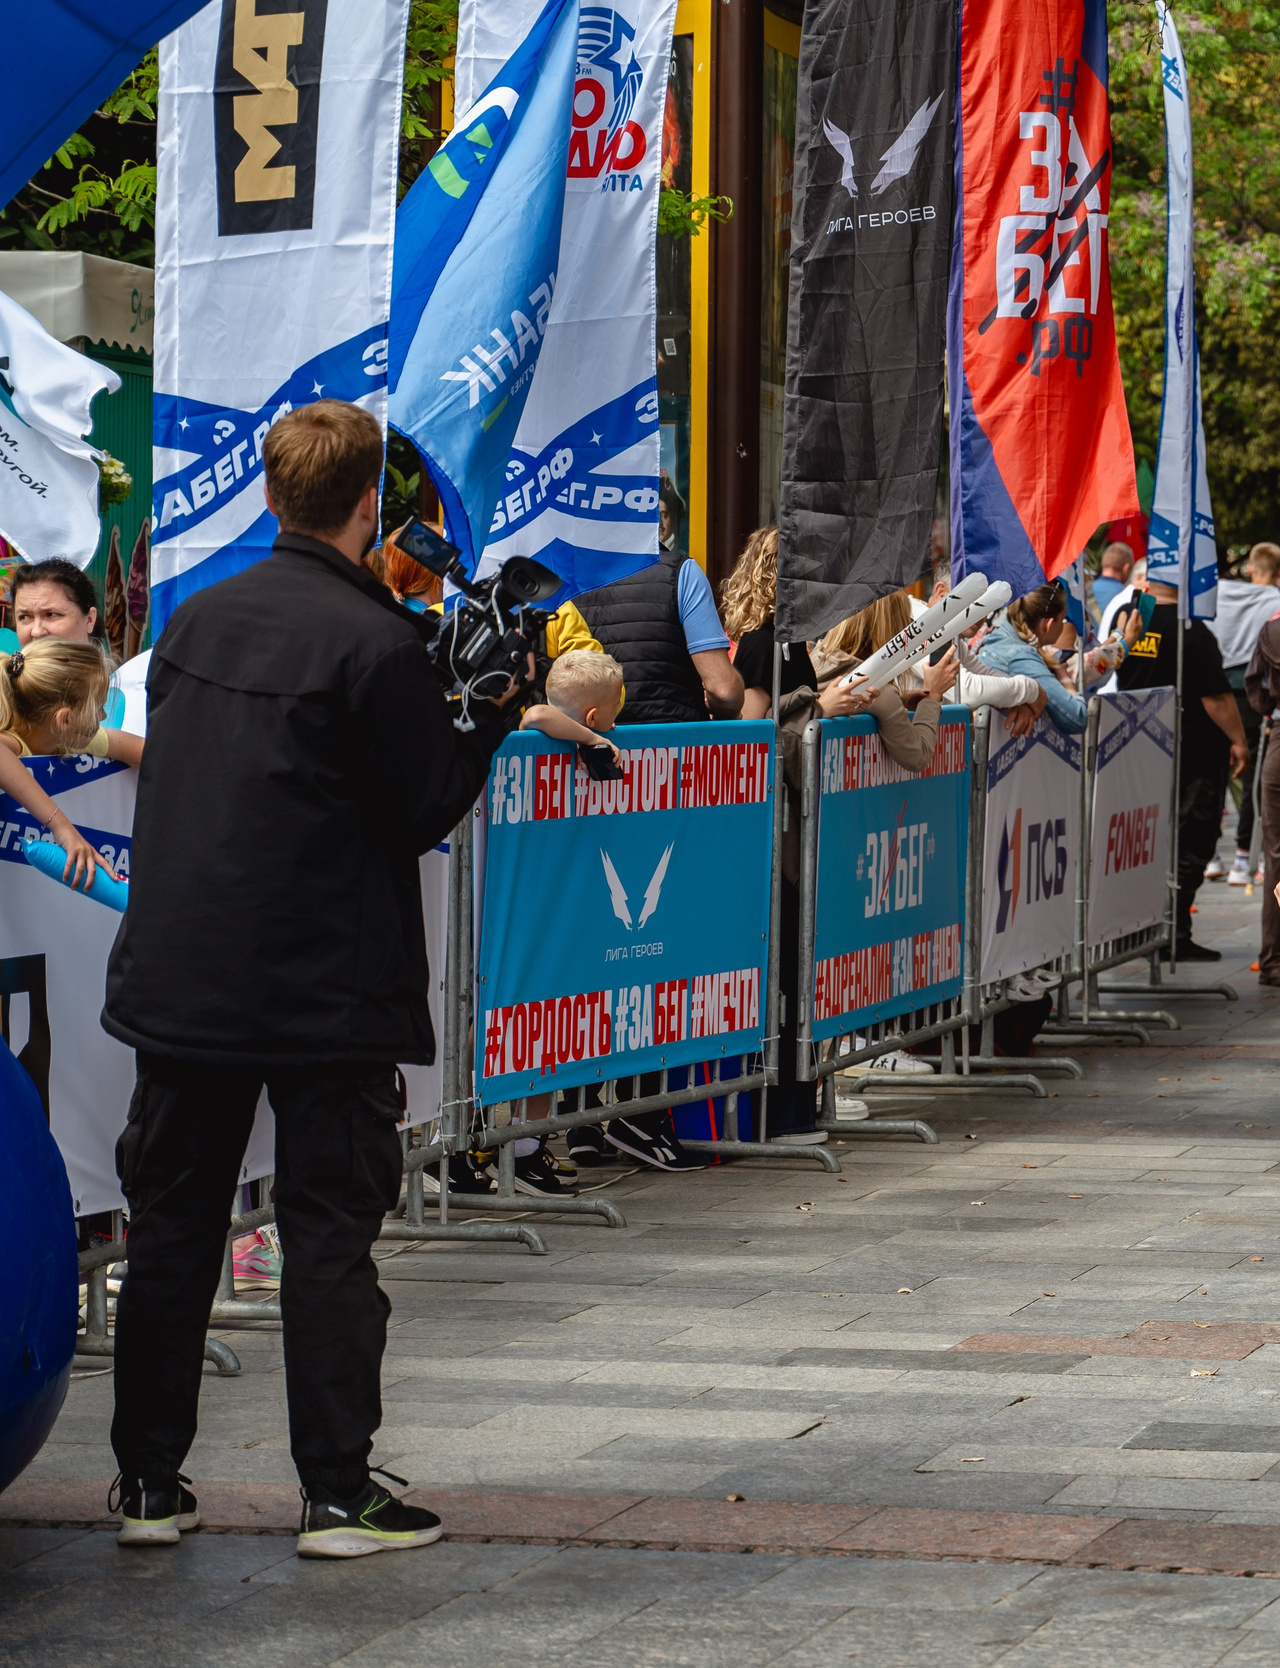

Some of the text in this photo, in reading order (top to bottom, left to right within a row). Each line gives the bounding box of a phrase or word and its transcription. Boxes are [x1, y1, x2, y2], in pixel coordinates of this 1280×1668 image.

[1019, 111, 1101, 217] ЗА
[826, 205, 936, 235] ЛИГА ГЕРОЕВ
[996, 213, 1108, 318] БЕГ
[680, 742, 769, 809] #МОМЕНТ
[1027, 818, 1067, 905] ПСБ
[1105, 804, 1160, 876] FONBET
[604, 942, 664, 962] ЛИГА ГЕРОЕВ
[815, 942, 892, 1021] #АДРЕНАЛИН
[483, 990, 612, 1078] #ГОРДОСТЬ
[690, 967, 761, 1039] #МЕЧТА
